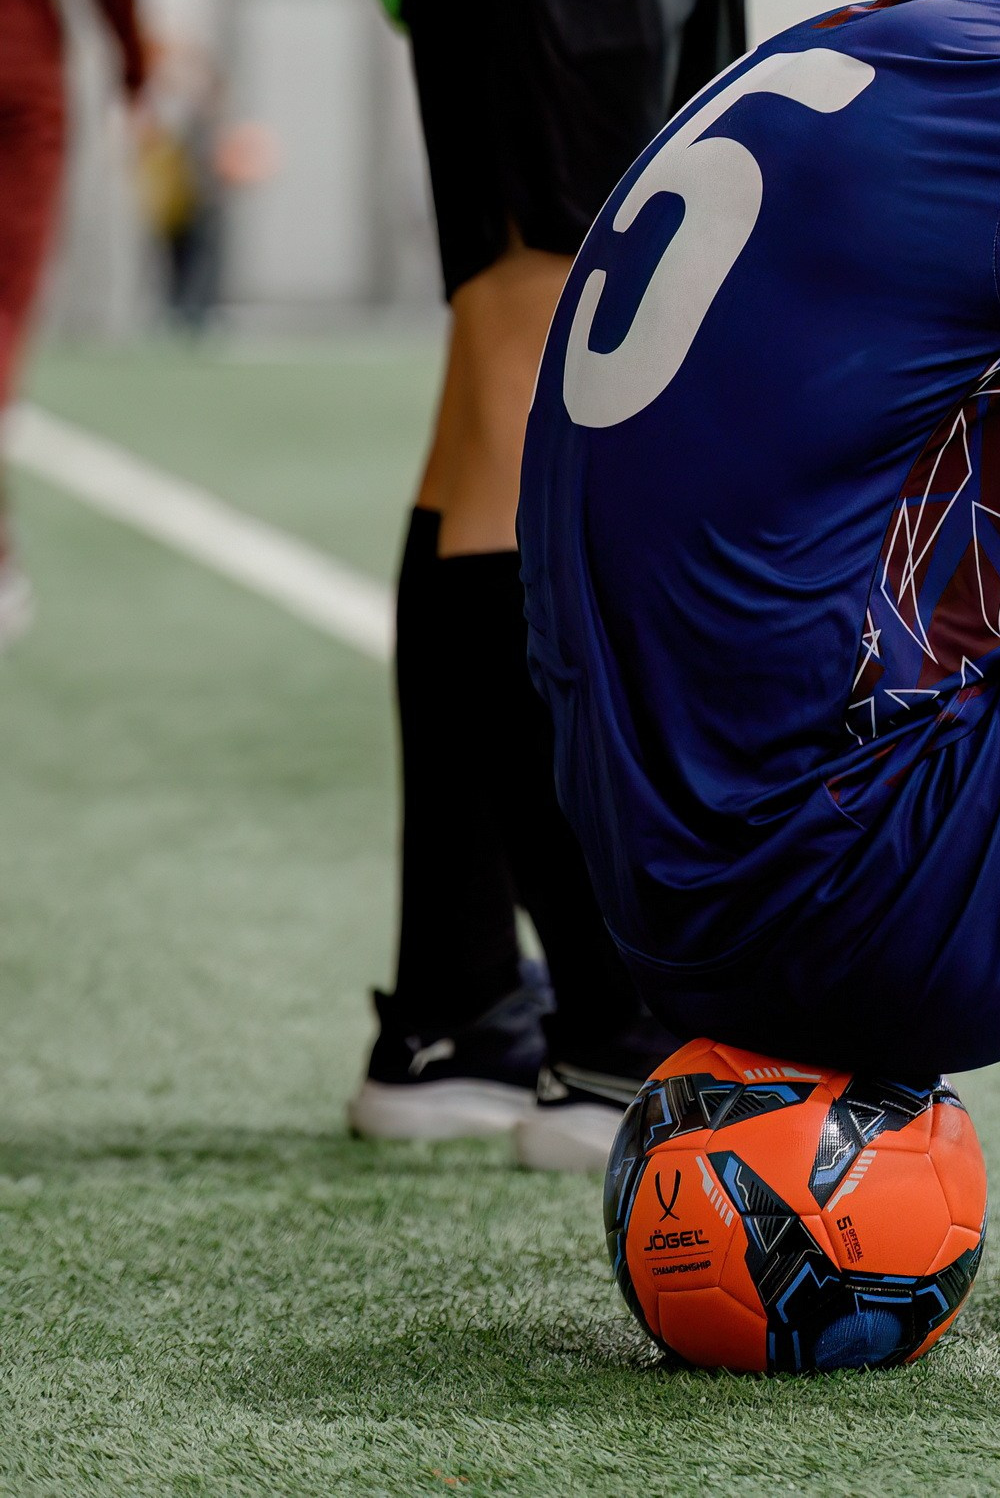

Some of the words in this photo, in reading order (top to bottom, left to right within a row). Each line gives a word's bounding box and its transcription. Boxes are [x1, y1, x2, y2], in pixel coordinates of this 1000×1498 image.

[528, 45, 876, 428] 5
[836, 1215, 852, 1231] 5
[643, 1228, 710, 1252] JÖGEL
[848, 1228, 864, 1261] OFFICIAL
